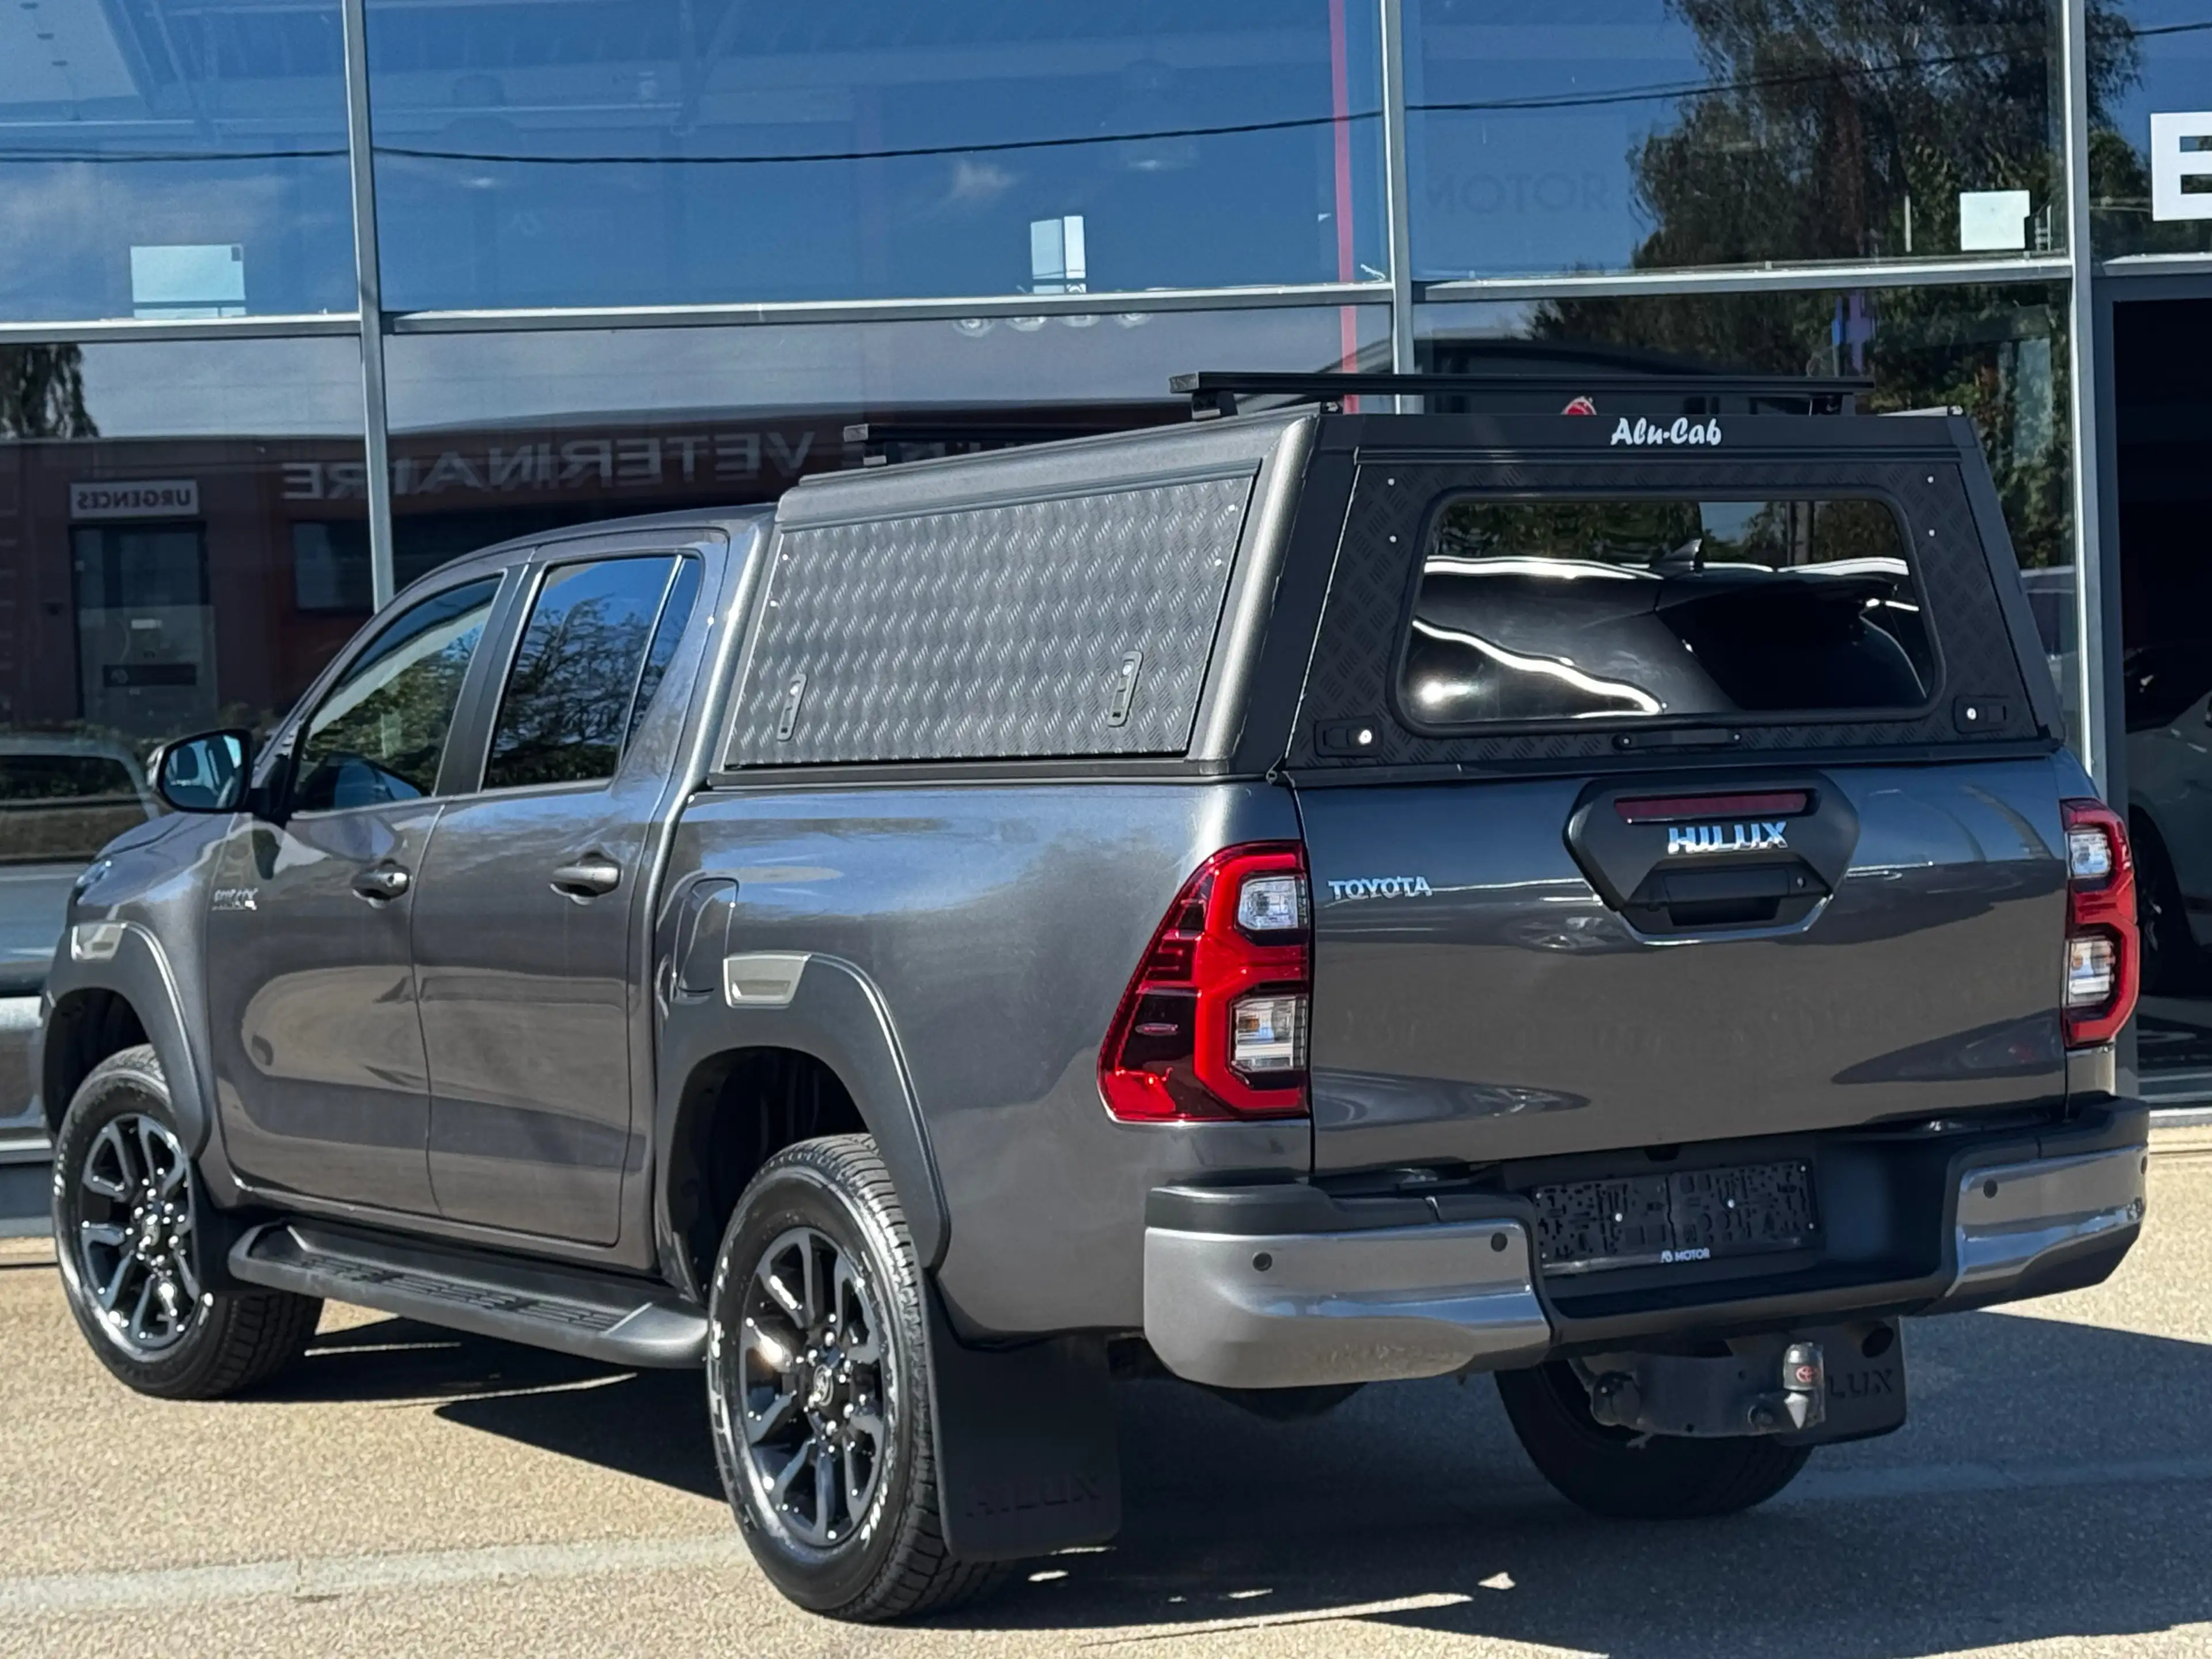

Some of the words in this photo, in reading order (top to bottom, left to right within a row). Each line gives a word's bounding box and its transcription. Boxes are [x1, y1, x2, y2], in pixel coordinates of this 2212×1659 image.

[1611, 416, 1722, 446] Alu-Cab
[1667, 821, 1789, 854] HILUX
[1328, 876, 1433, 900] TOYOTA
[1675, 1248, 1710, 1262] MOTOR
[1826, 1368, 1893, 1399] LUX
